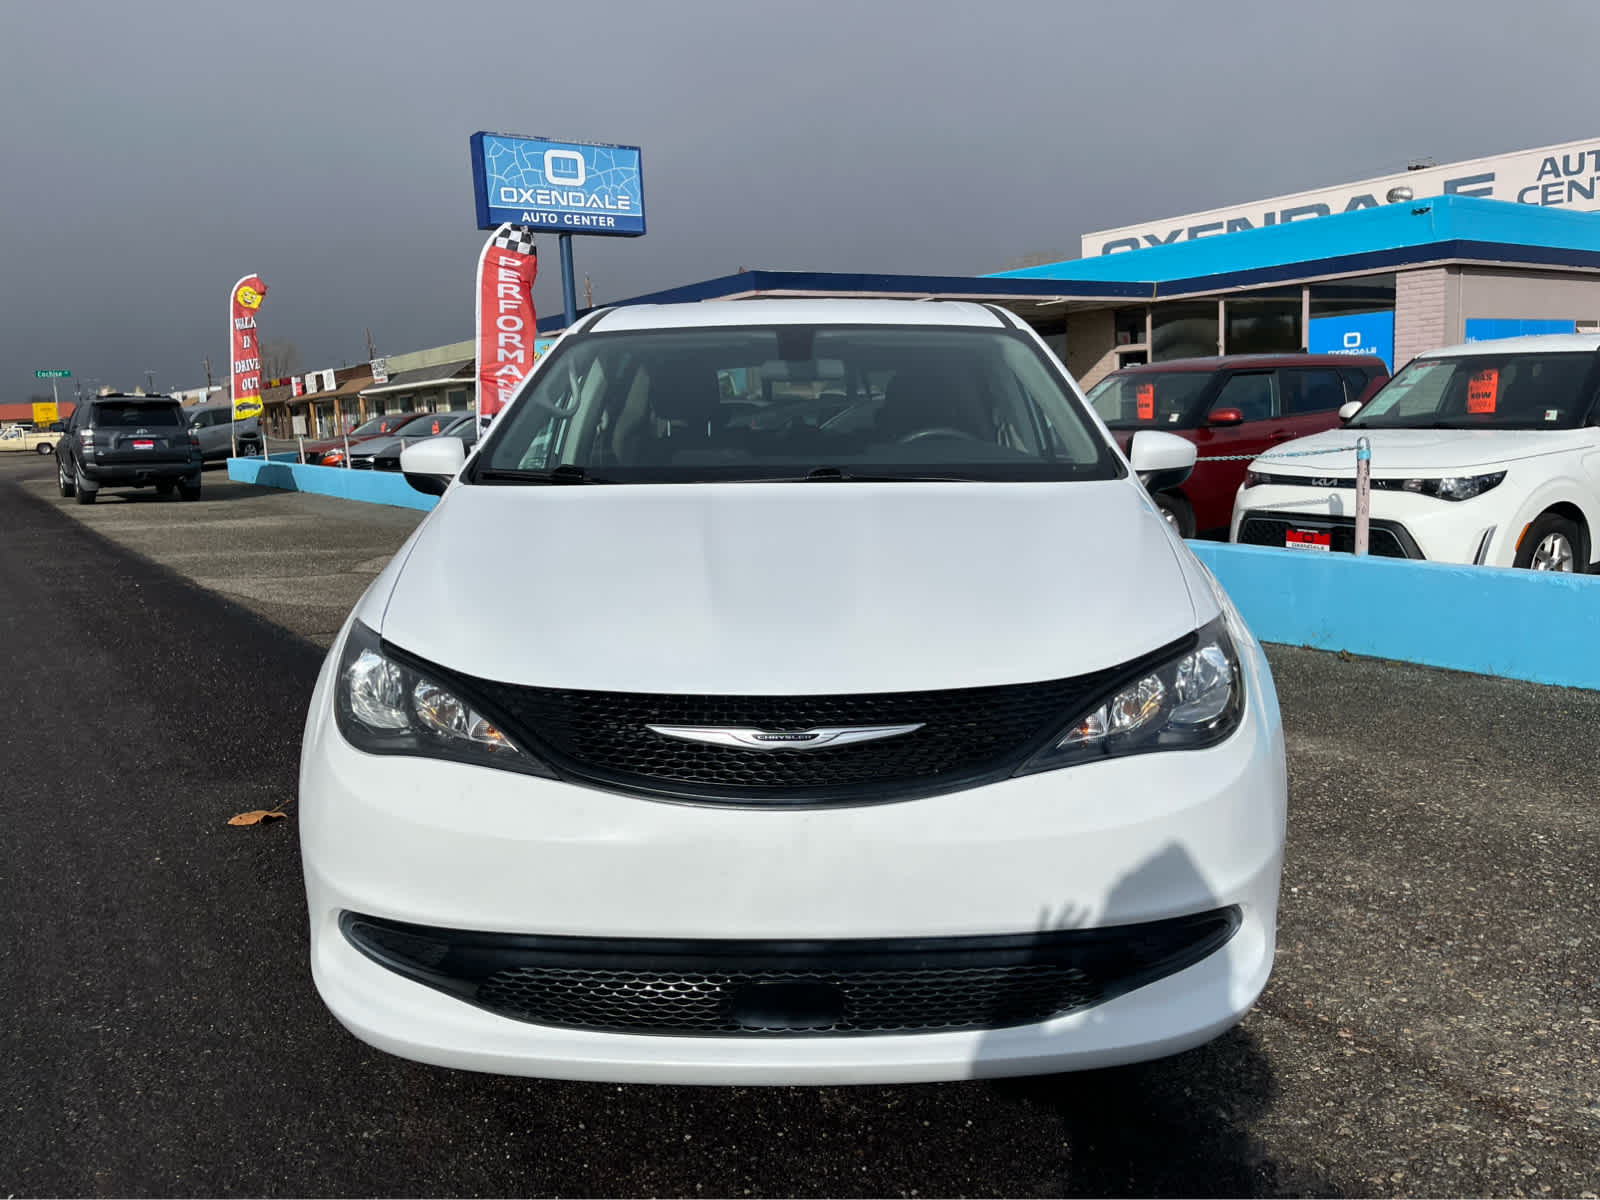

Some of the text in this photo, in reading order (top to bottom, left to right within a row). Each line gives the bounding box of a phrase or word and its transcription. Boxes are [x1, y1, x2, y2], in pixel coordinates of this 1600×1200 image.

[500, 187, 631, 210] OXENDALE
[521, 211, 615, 227] AUTO CENTER
